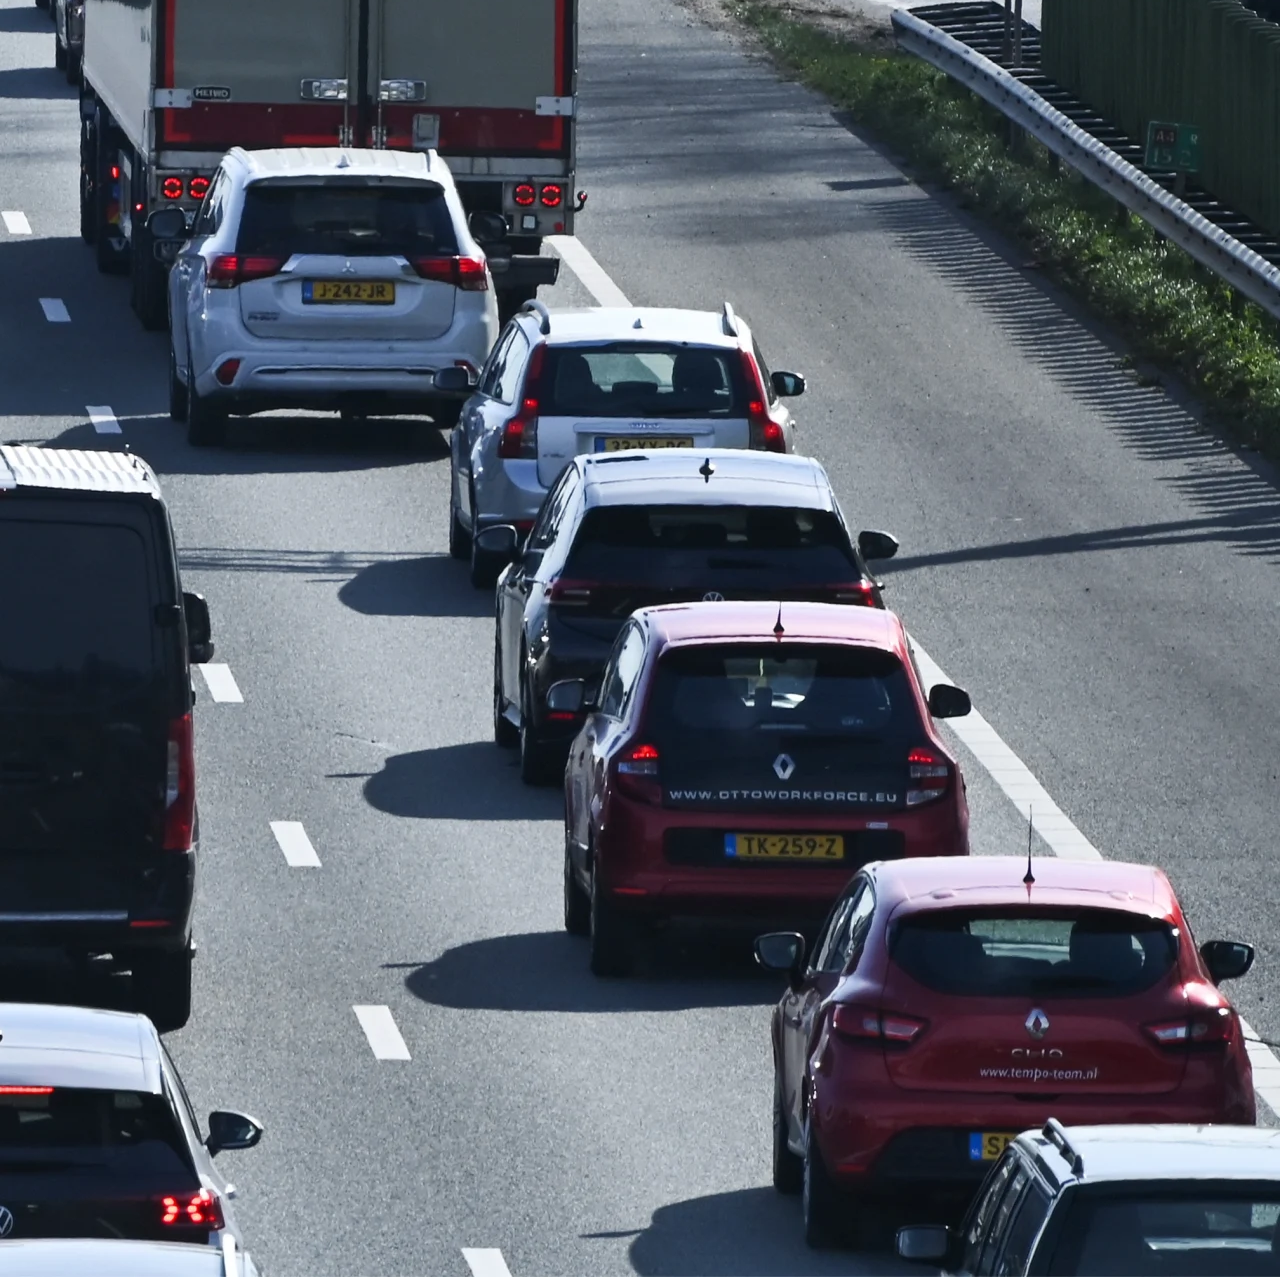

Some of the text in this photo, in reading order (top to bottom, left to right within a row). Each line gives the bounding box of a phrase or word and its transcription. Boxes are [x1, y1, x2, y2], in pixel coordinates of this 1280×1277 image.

[318, 281, 386, 299] J-242-JR
[669, 790, 898, 803] WWW.OTTOWORKFORCE.EU
[742, 837, 837, 858] TK-259-Z
[979, 1066, 1098, 1083] www.tempo-team.nl
